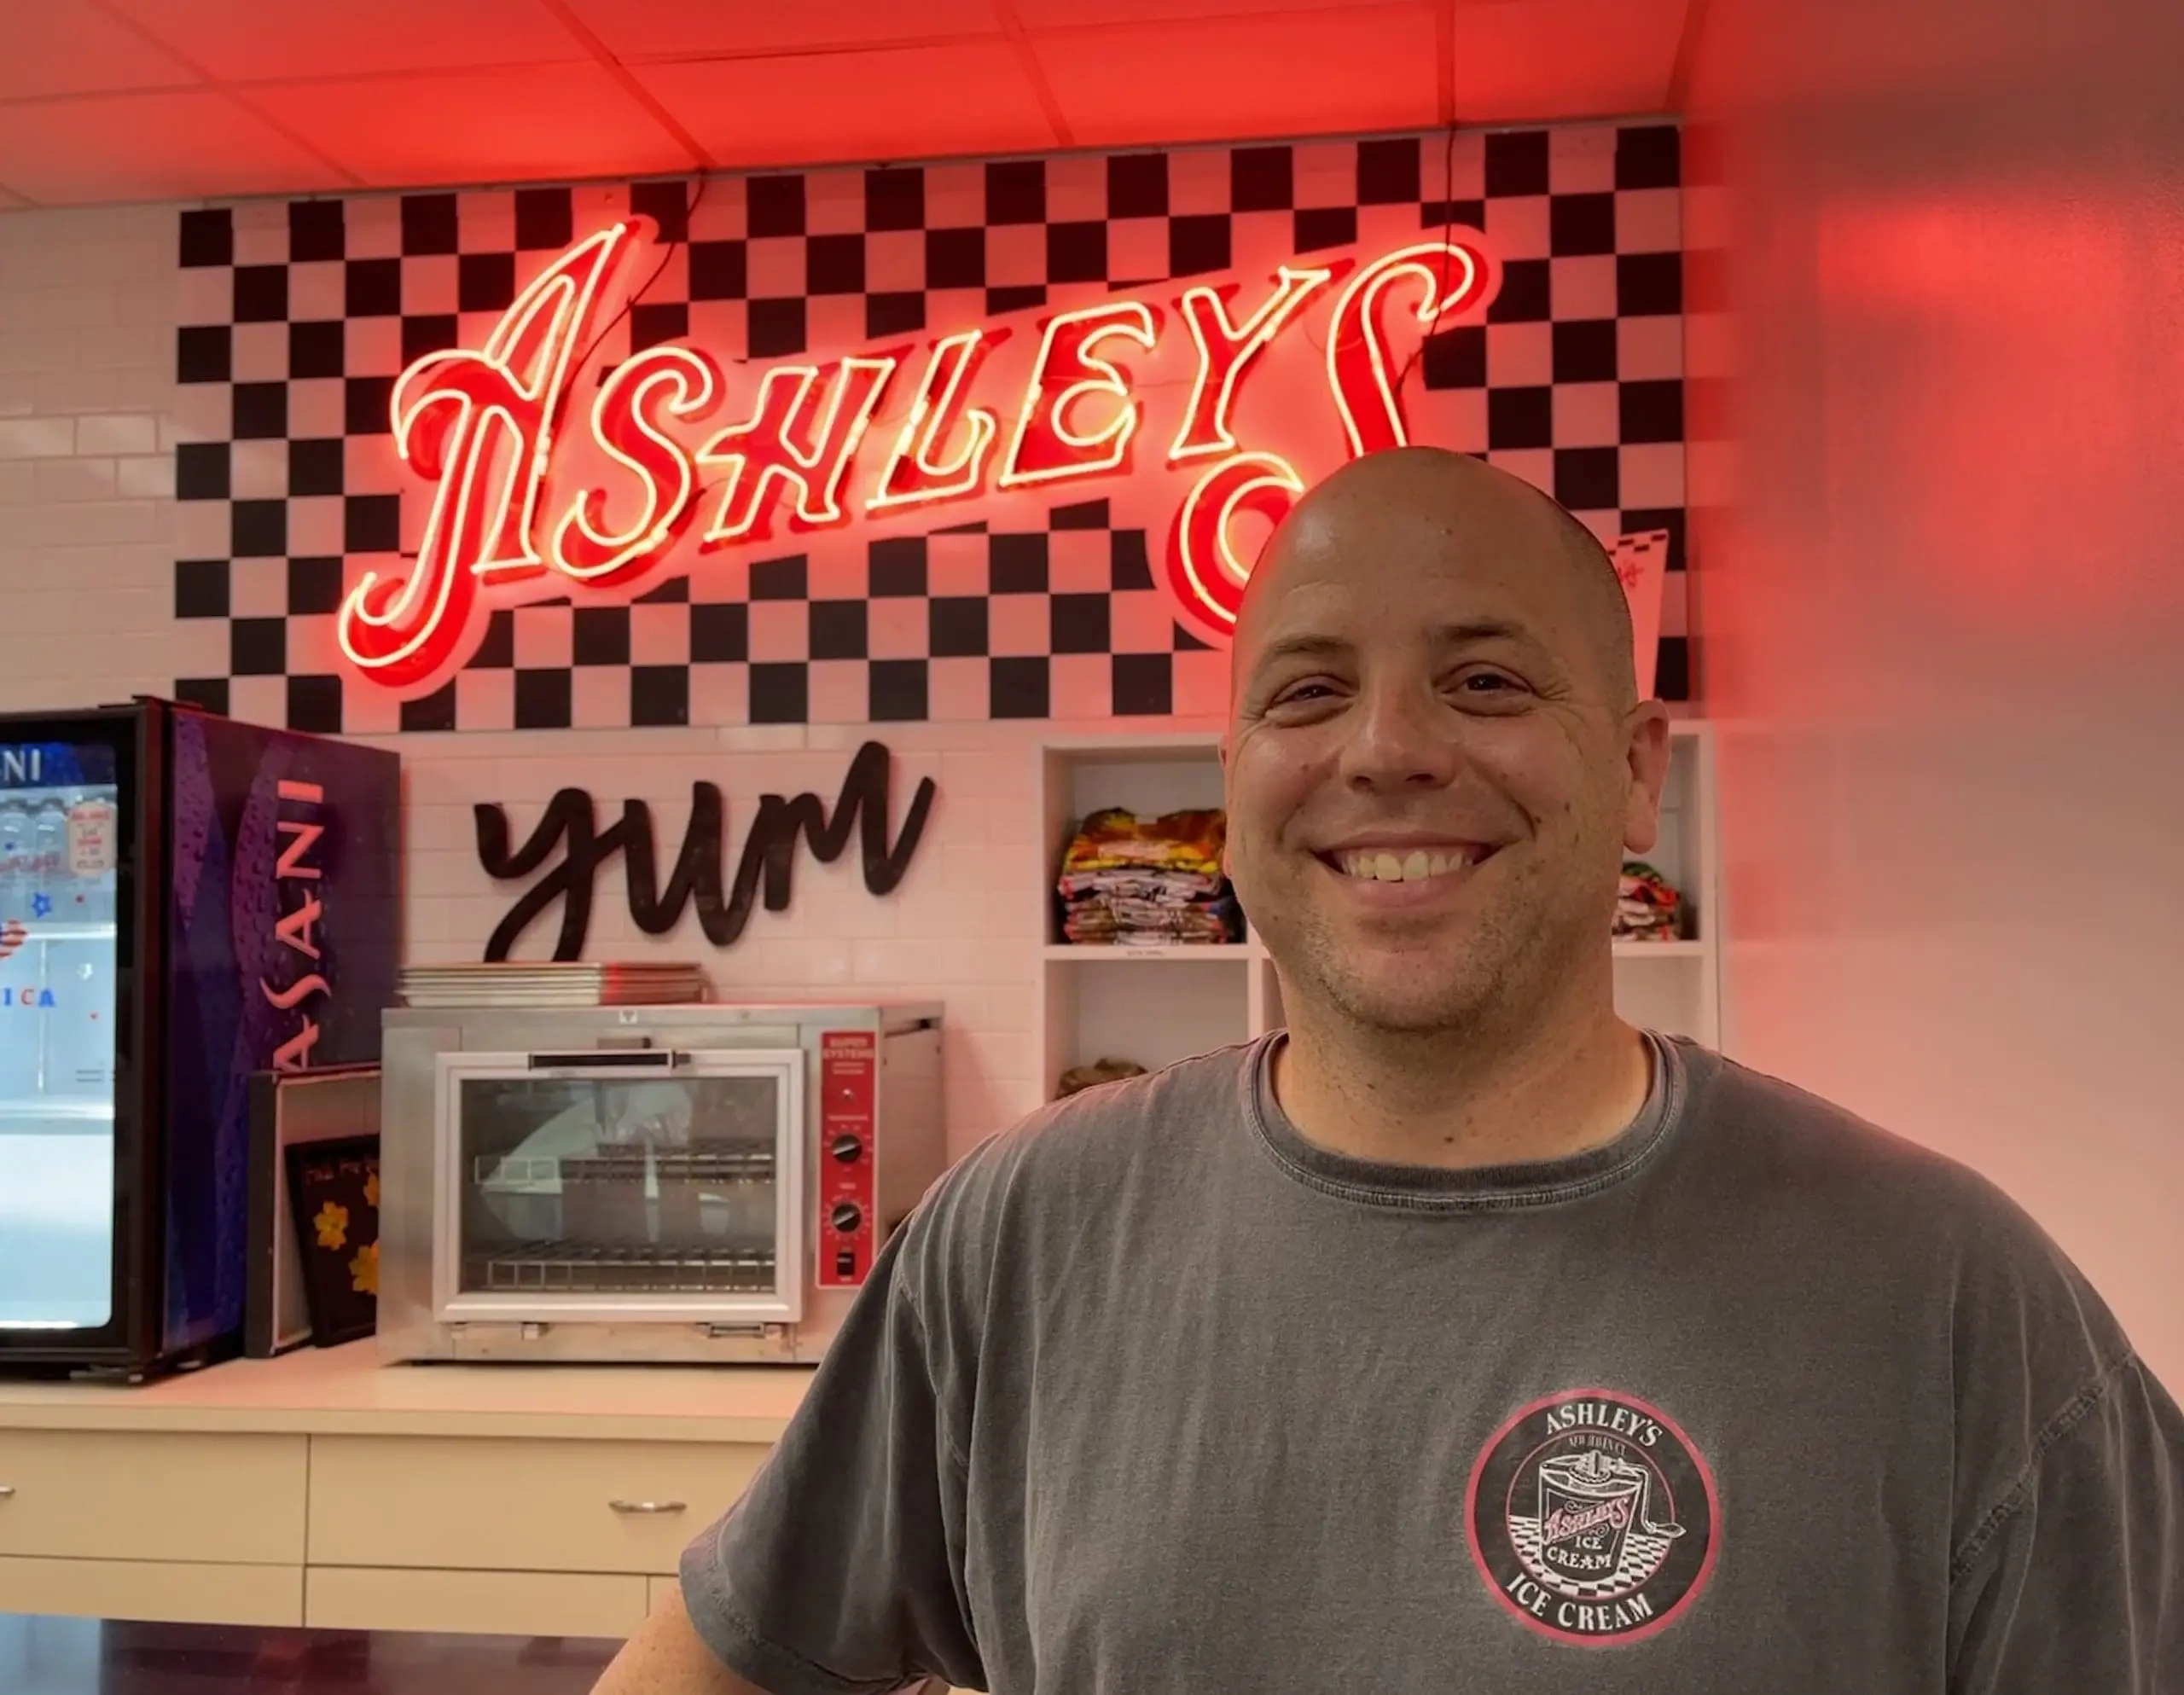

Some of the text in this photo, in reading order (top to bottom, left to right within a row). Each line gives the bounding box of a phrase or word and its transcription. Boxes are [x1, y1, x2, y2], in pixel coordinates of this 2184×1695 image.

[474, 740, 936, 962] yum
[1546, 1402, 1663, 1447] ASHLEY'S
[1546, 1547, 1612, 1570] CREAM
[1576, 1535, 1603, 1550] ICE
[1507, 1572, 1653, 1631] ICE CREAM
